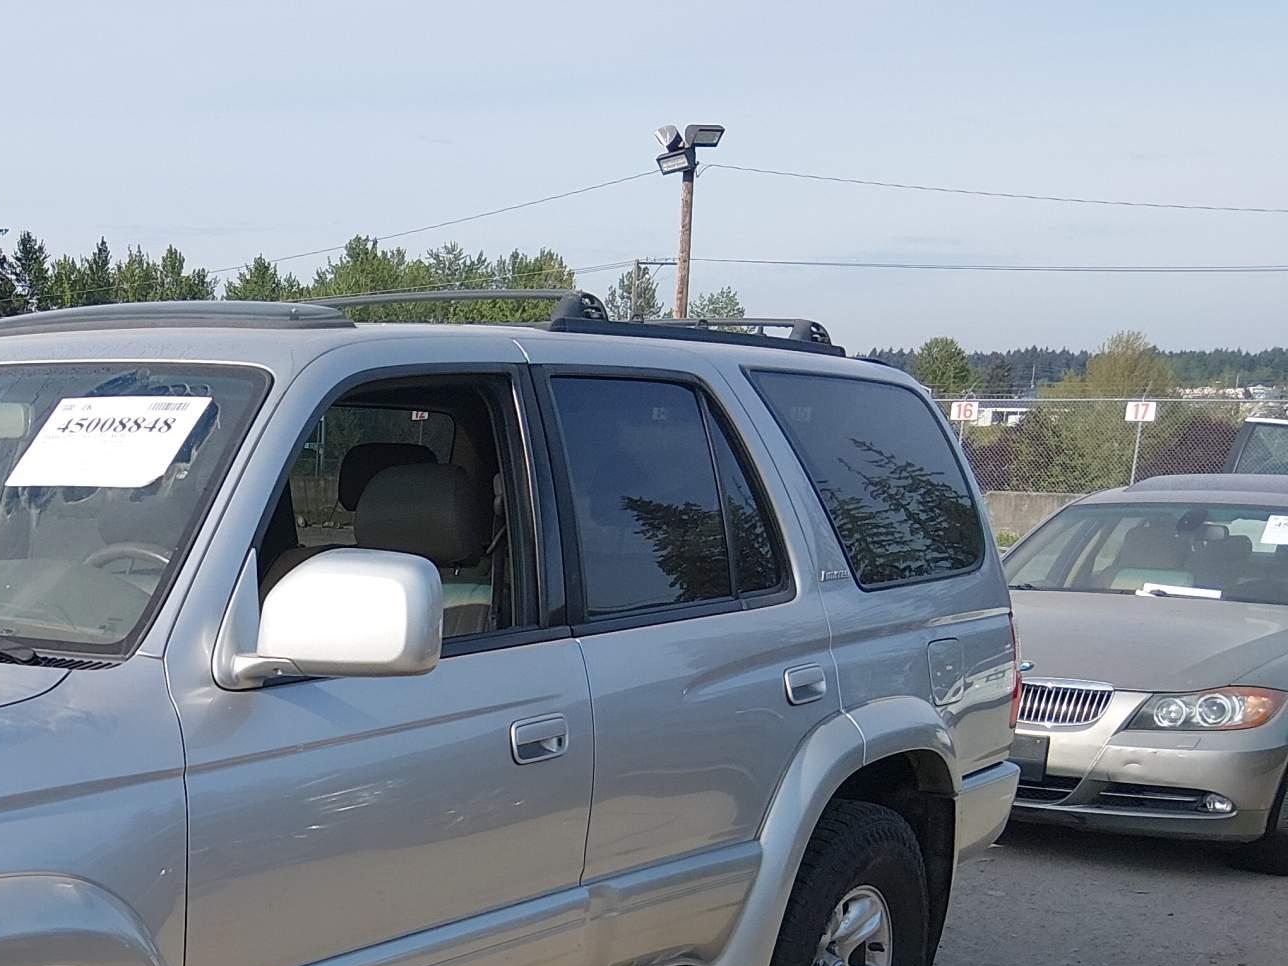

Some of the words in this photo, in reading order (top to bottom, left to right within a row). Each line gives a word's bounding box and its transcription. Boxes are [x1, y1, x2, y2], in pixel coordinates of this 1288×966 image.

[956, 403, 973, 418] 16
[1134, 403, 1149, 419] 17
[56, 416, 177, 434] 45008848
